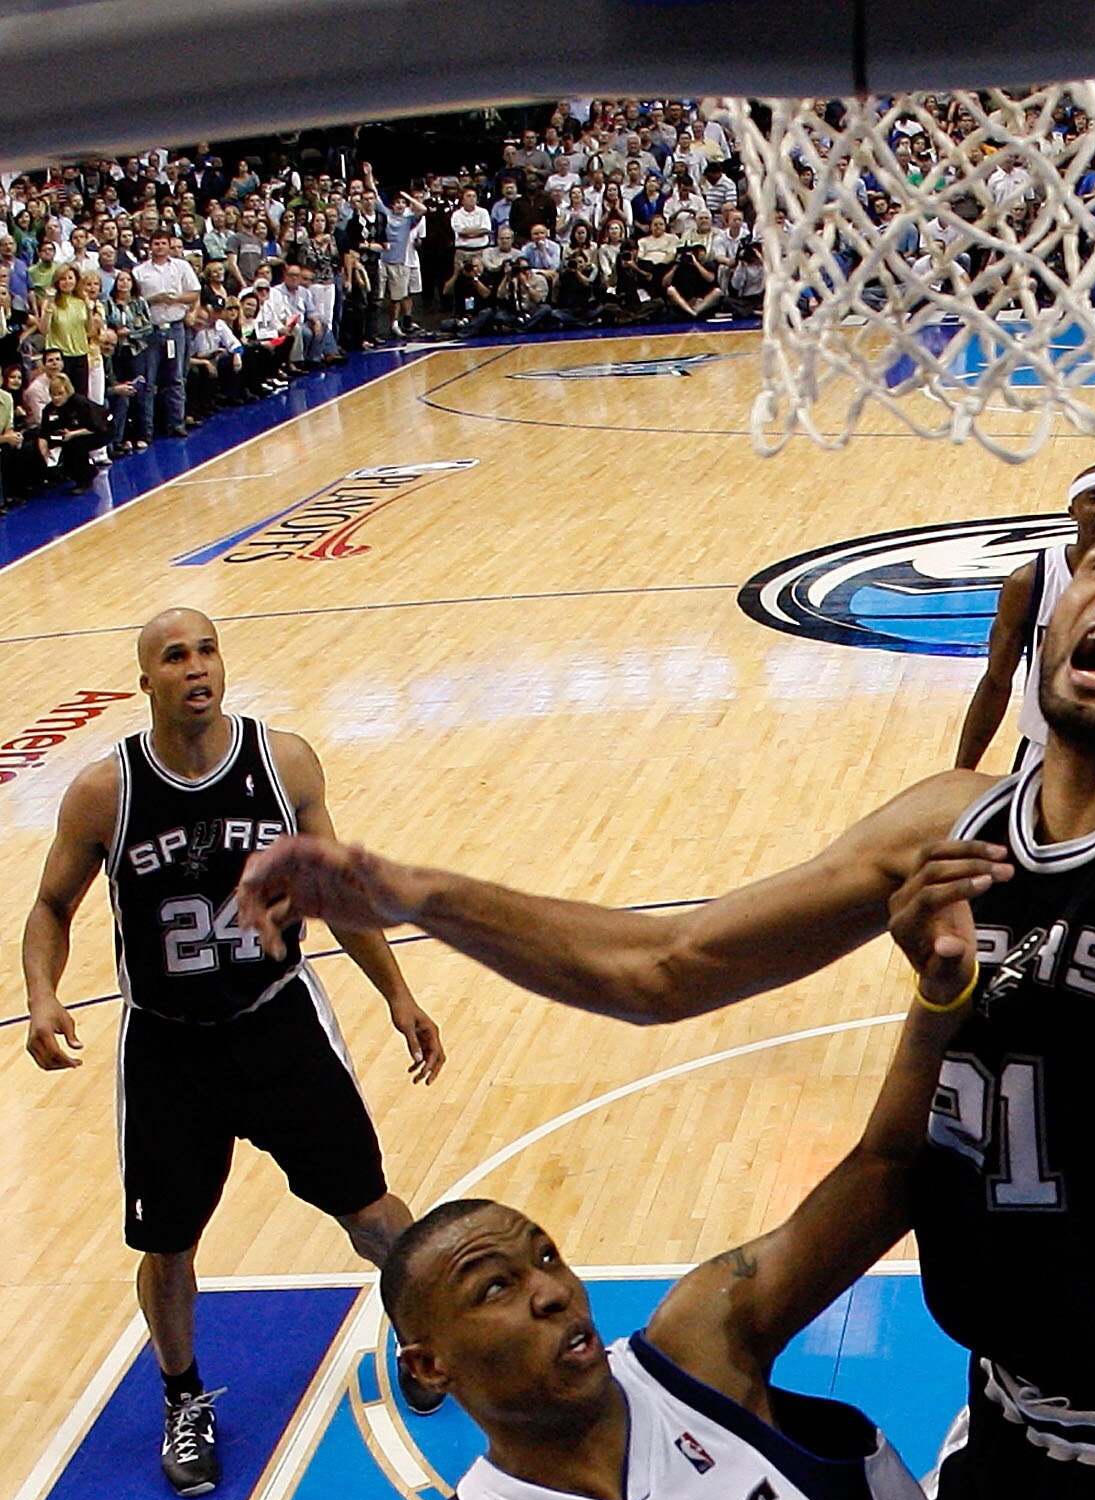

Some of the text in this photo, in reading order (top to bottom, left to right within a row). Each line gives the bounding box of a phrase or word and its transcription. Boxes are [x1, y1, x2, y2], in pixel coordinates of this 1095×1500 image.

[223, 473, 423, 563] PLAYOFFS
[0, 690, 137, 785] Ameri
[159, 893, 266, 978] 24
